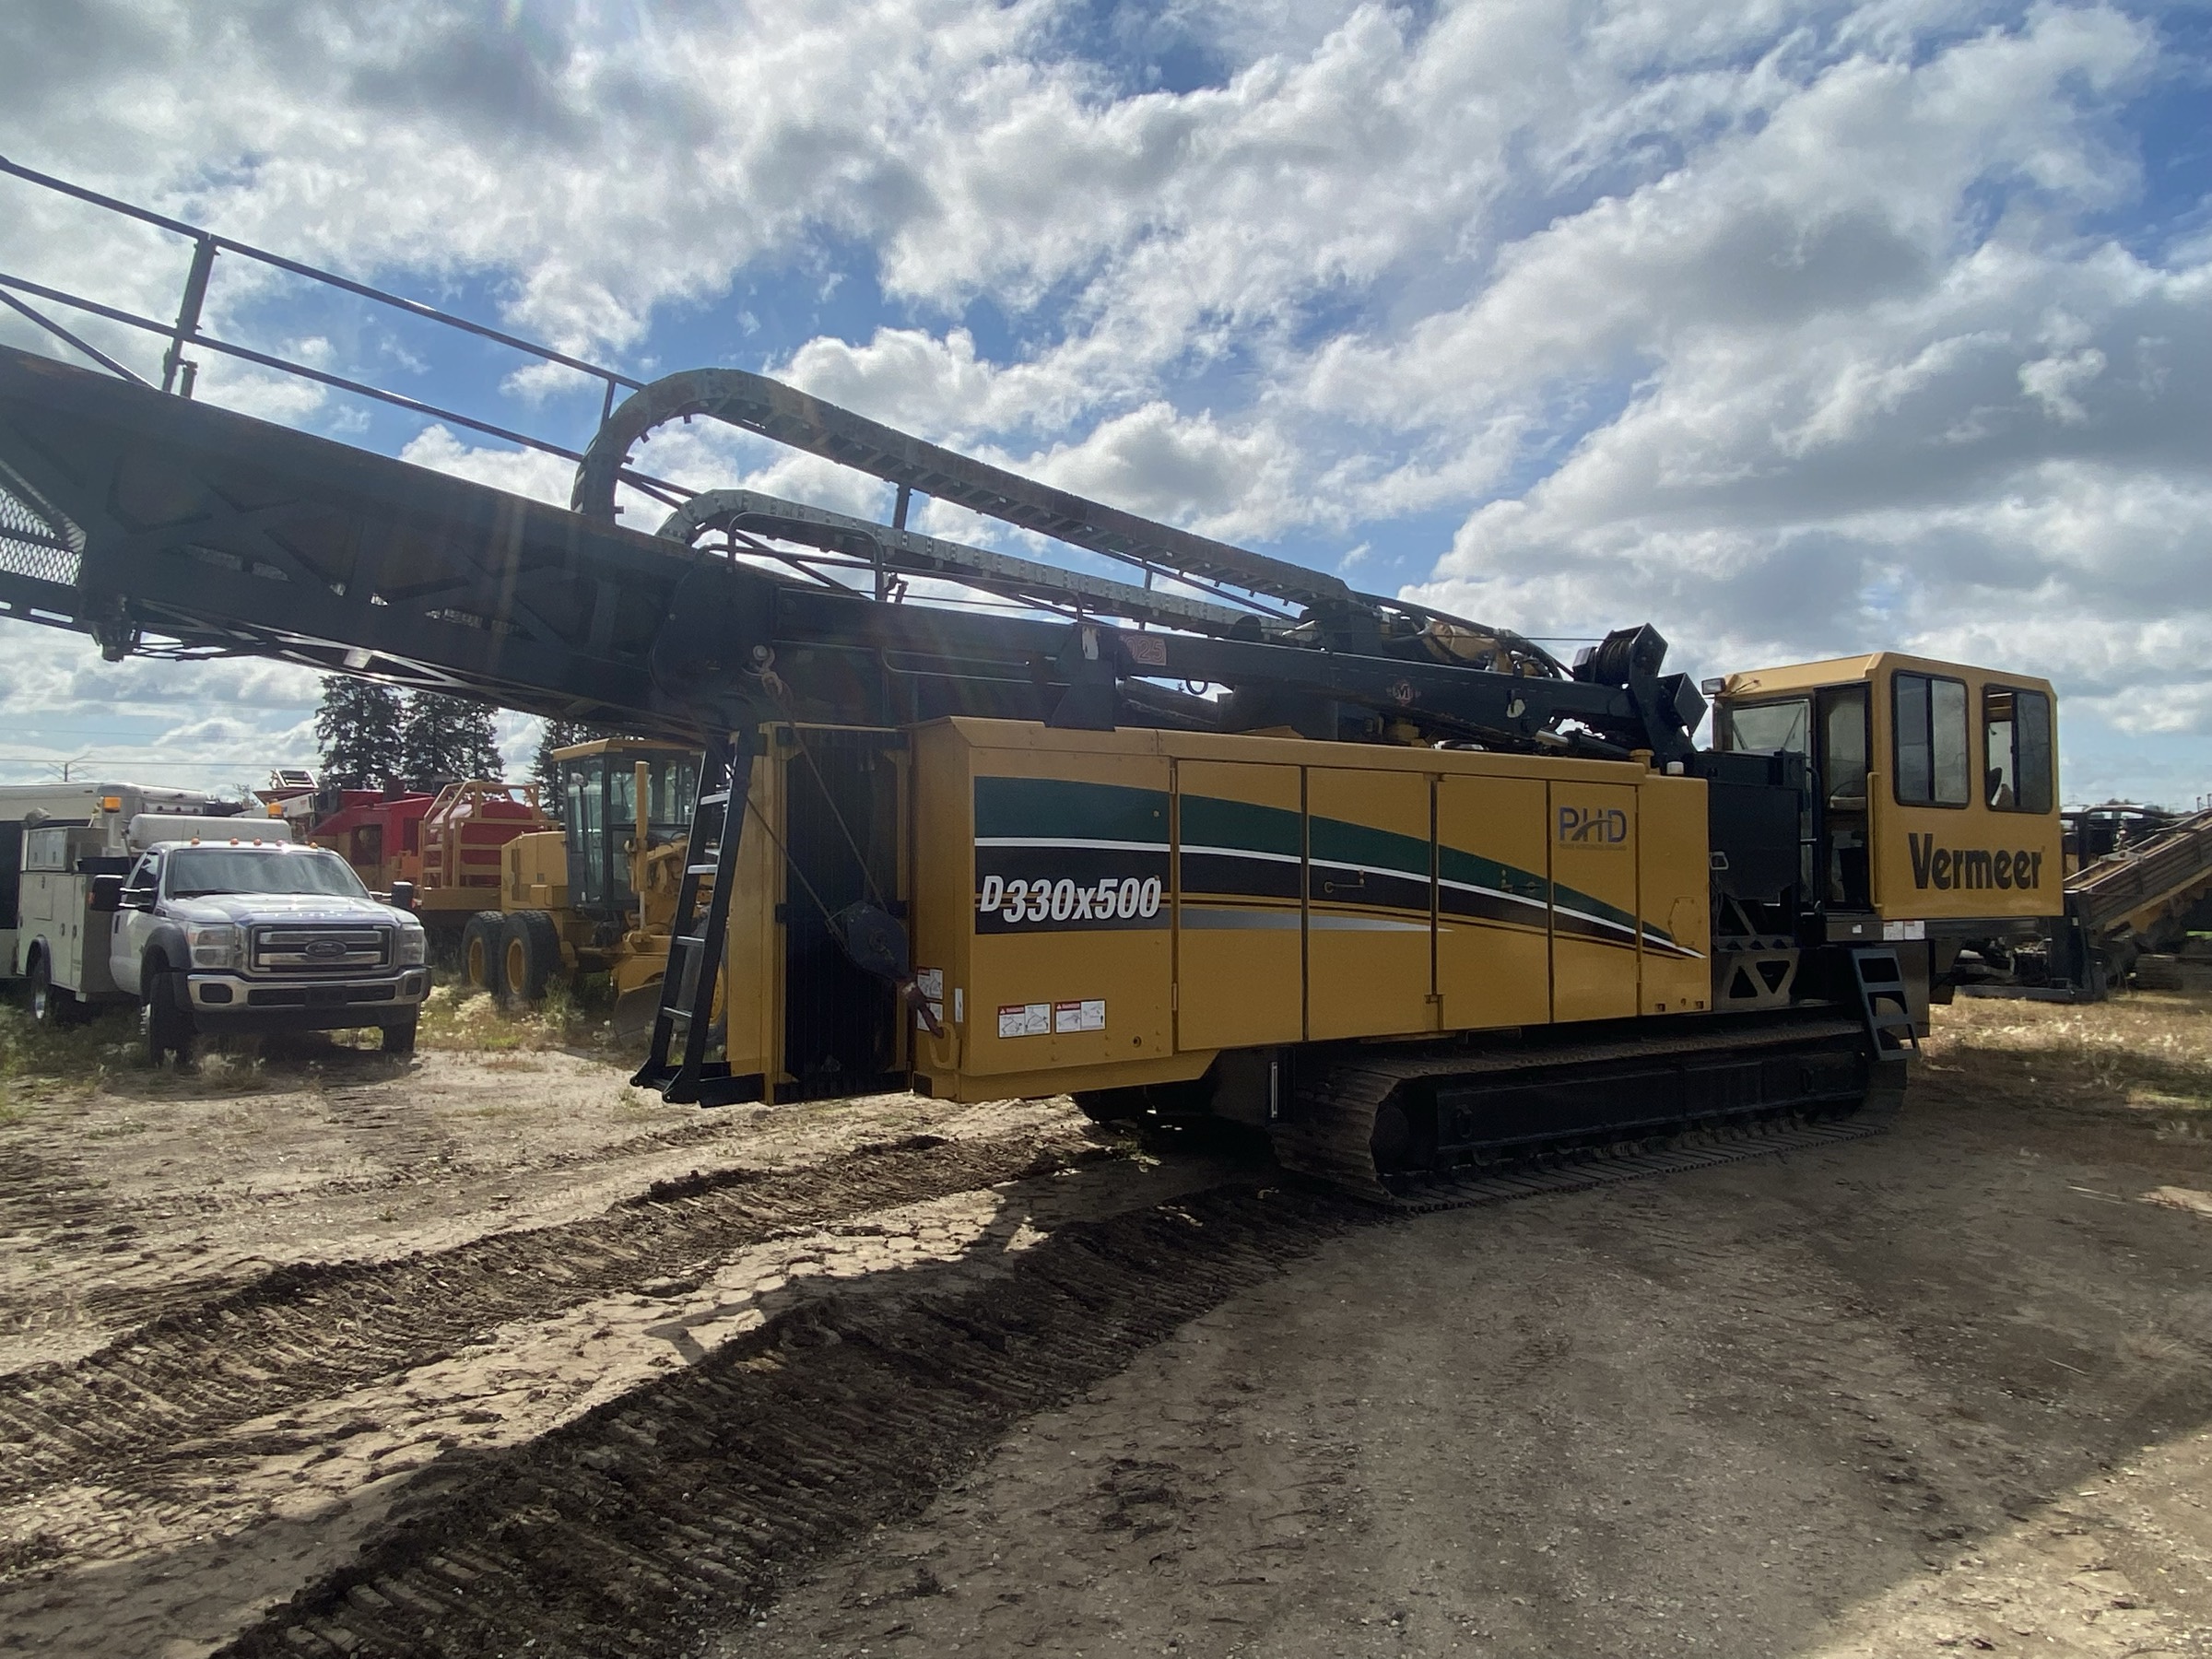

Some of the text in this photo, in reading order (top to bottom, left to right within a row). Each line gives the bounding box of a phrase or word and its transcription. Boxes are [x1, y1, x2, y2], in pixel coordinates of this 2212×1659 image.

[1559, 806, 1627, 842] PHD
[1908, 832, 2042, 889] Vermeer
[980, 876, 1161, 923] D330x500
